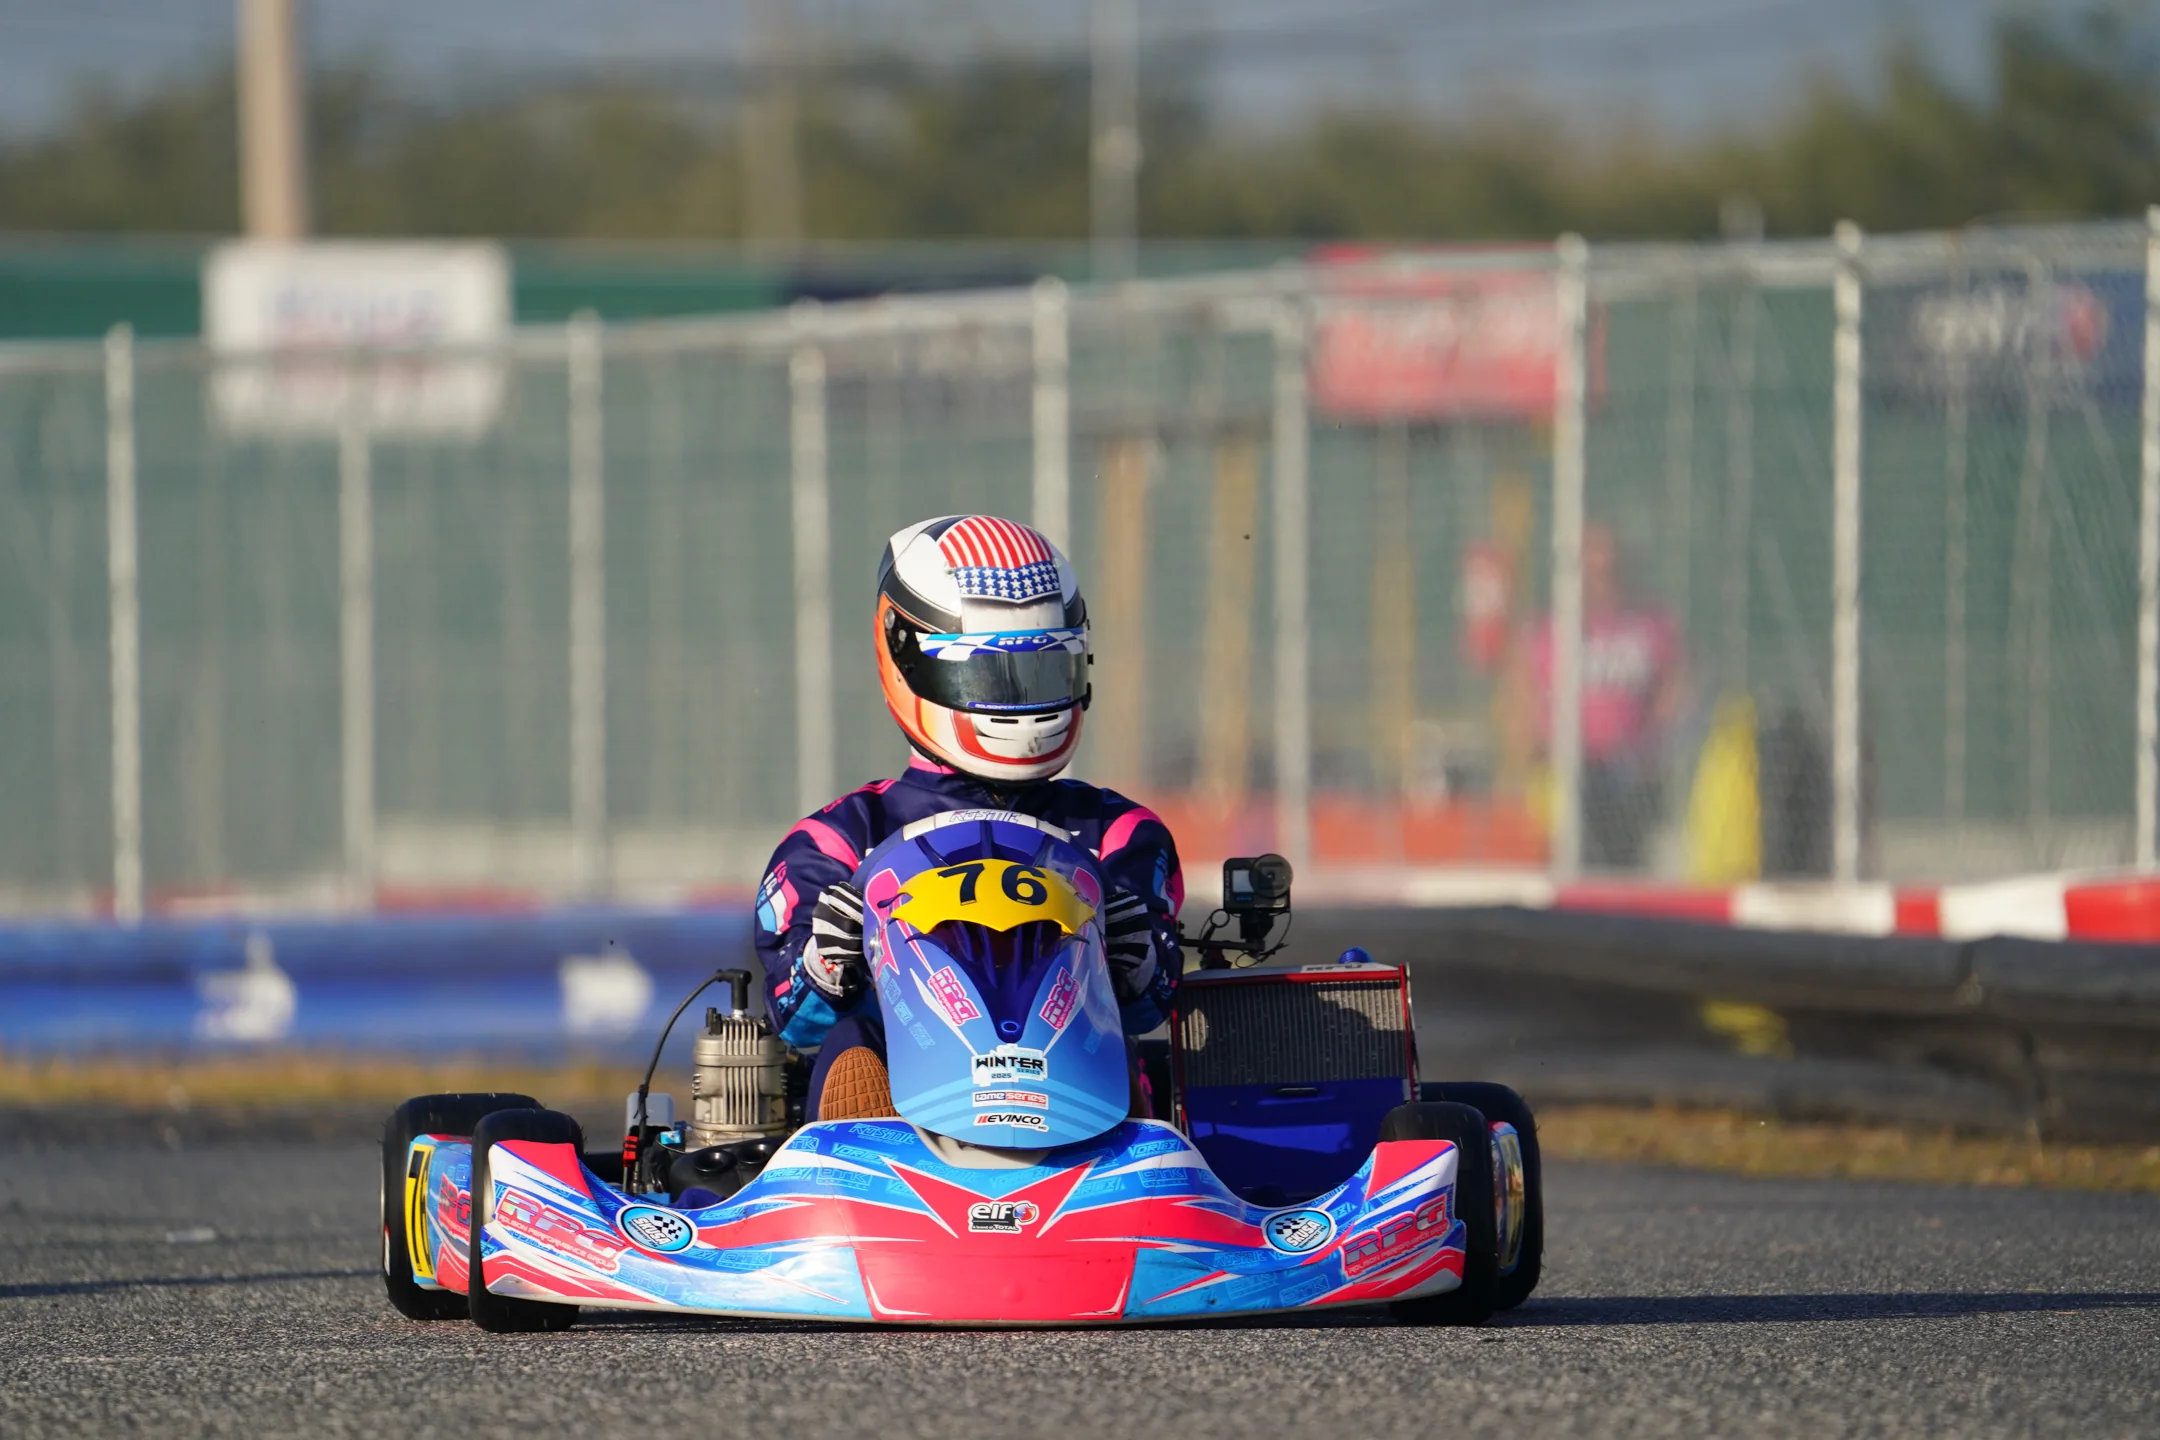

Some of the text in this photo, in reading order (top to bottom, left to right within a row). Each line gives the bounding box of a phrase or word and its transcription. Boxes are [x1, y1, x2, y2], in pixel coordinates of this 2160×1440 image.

[997, 635, 1048, 646] RPG
[937, 863, 1048, 906] 76
[935, 969, 977, 1019] RPG
[976, 1056, 1044, 1073] WINTER
[1016, 1067, 1041, 1075] SERIES
[987, 1114, 1042, 1125] EVINCO
[971, 1203, 1014, 1220] elf
[499, 1194, 625, 1259] RPG
[631, 1217, 673, 1246] SKUSA
[1285, 1220, 1322, 1248] SKUSA
[1345, 1202, 1446, 1266] RPG
